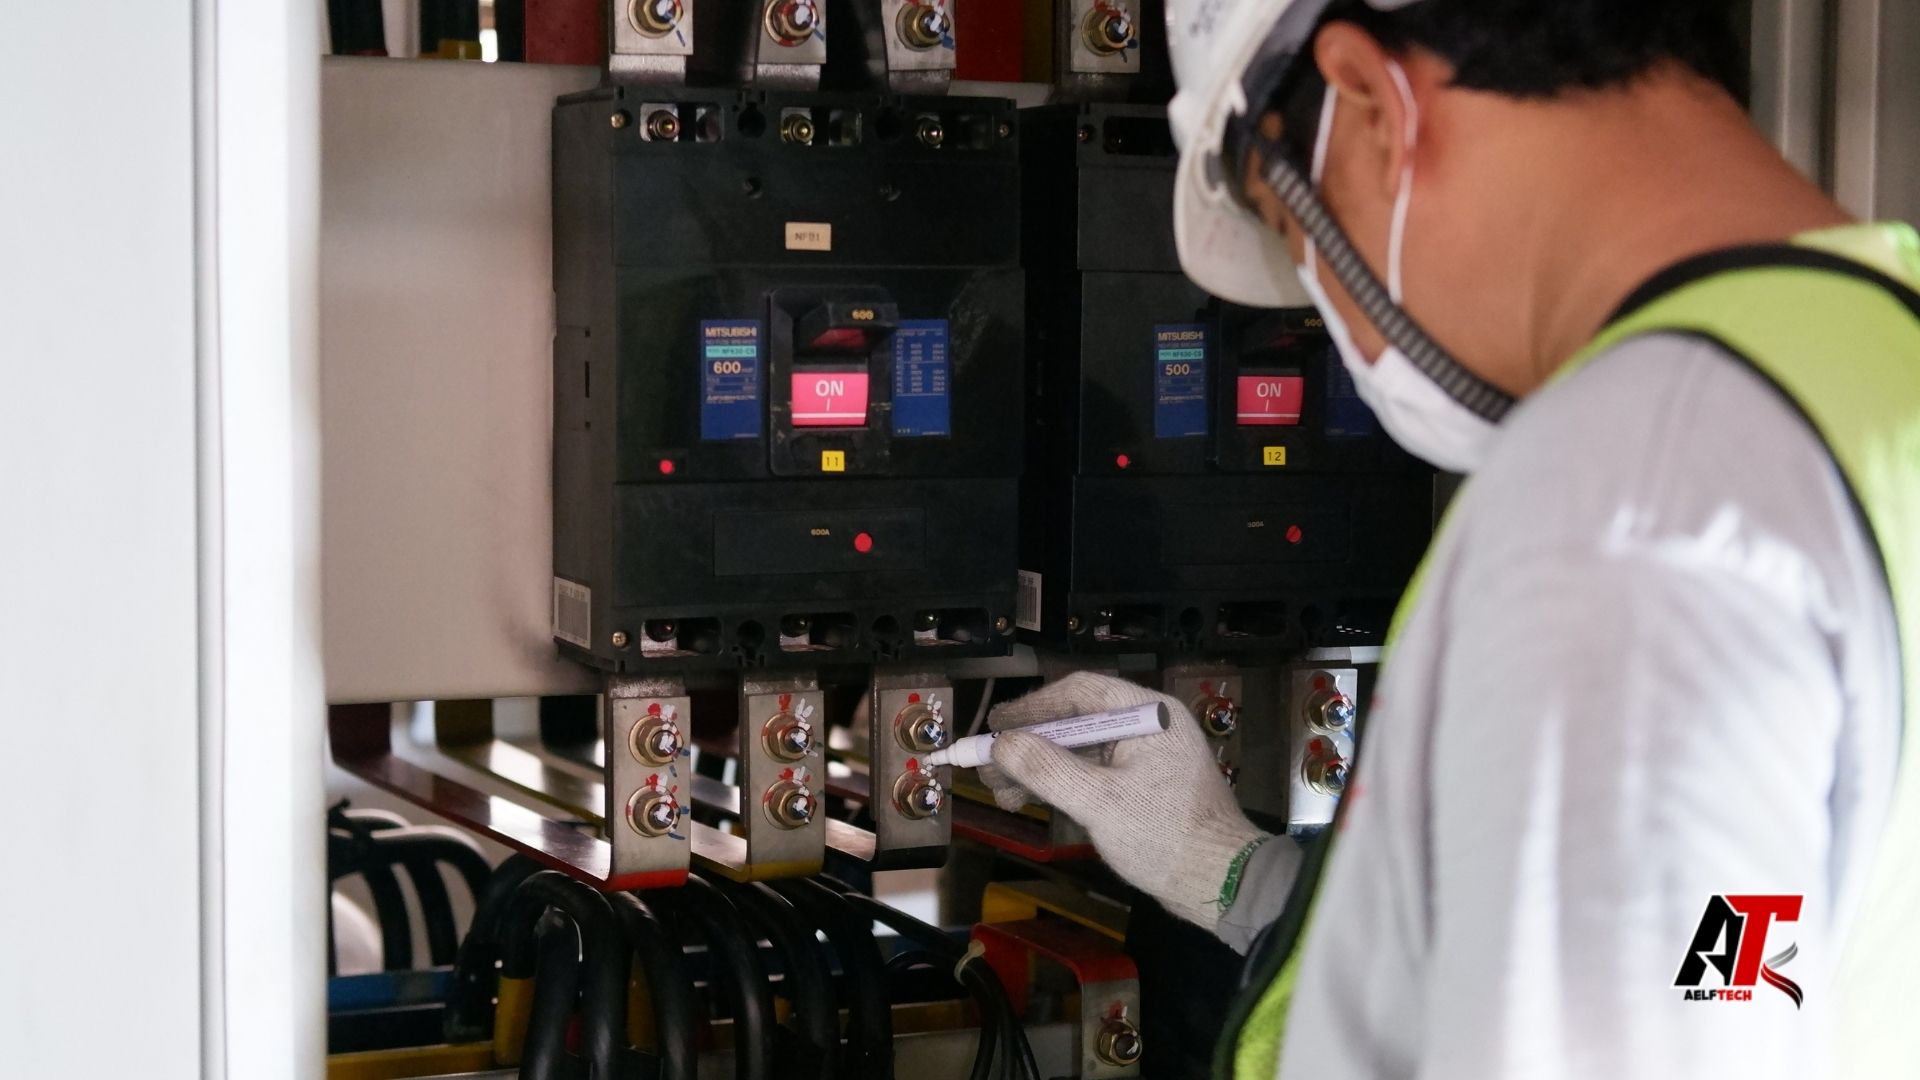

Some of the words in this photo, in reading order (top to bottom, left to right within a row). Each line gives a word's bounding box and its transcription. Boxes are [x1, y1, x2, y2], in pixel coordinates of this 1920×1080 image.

[852, 309, 874, 320] 600
[705, 327, 757, 337] MITSUBISHI
[1158, 331, 1204, 341] MITSUBISHI
[713, 361, 741, 374] 600
[1165, 363, 1190, 376] 500
[815, 380, 844, 397] ON
[1256, 382, 1282, 398] ON
[826, 456, 839, 467] 11
[1268, 451, 1282, 462] 12
